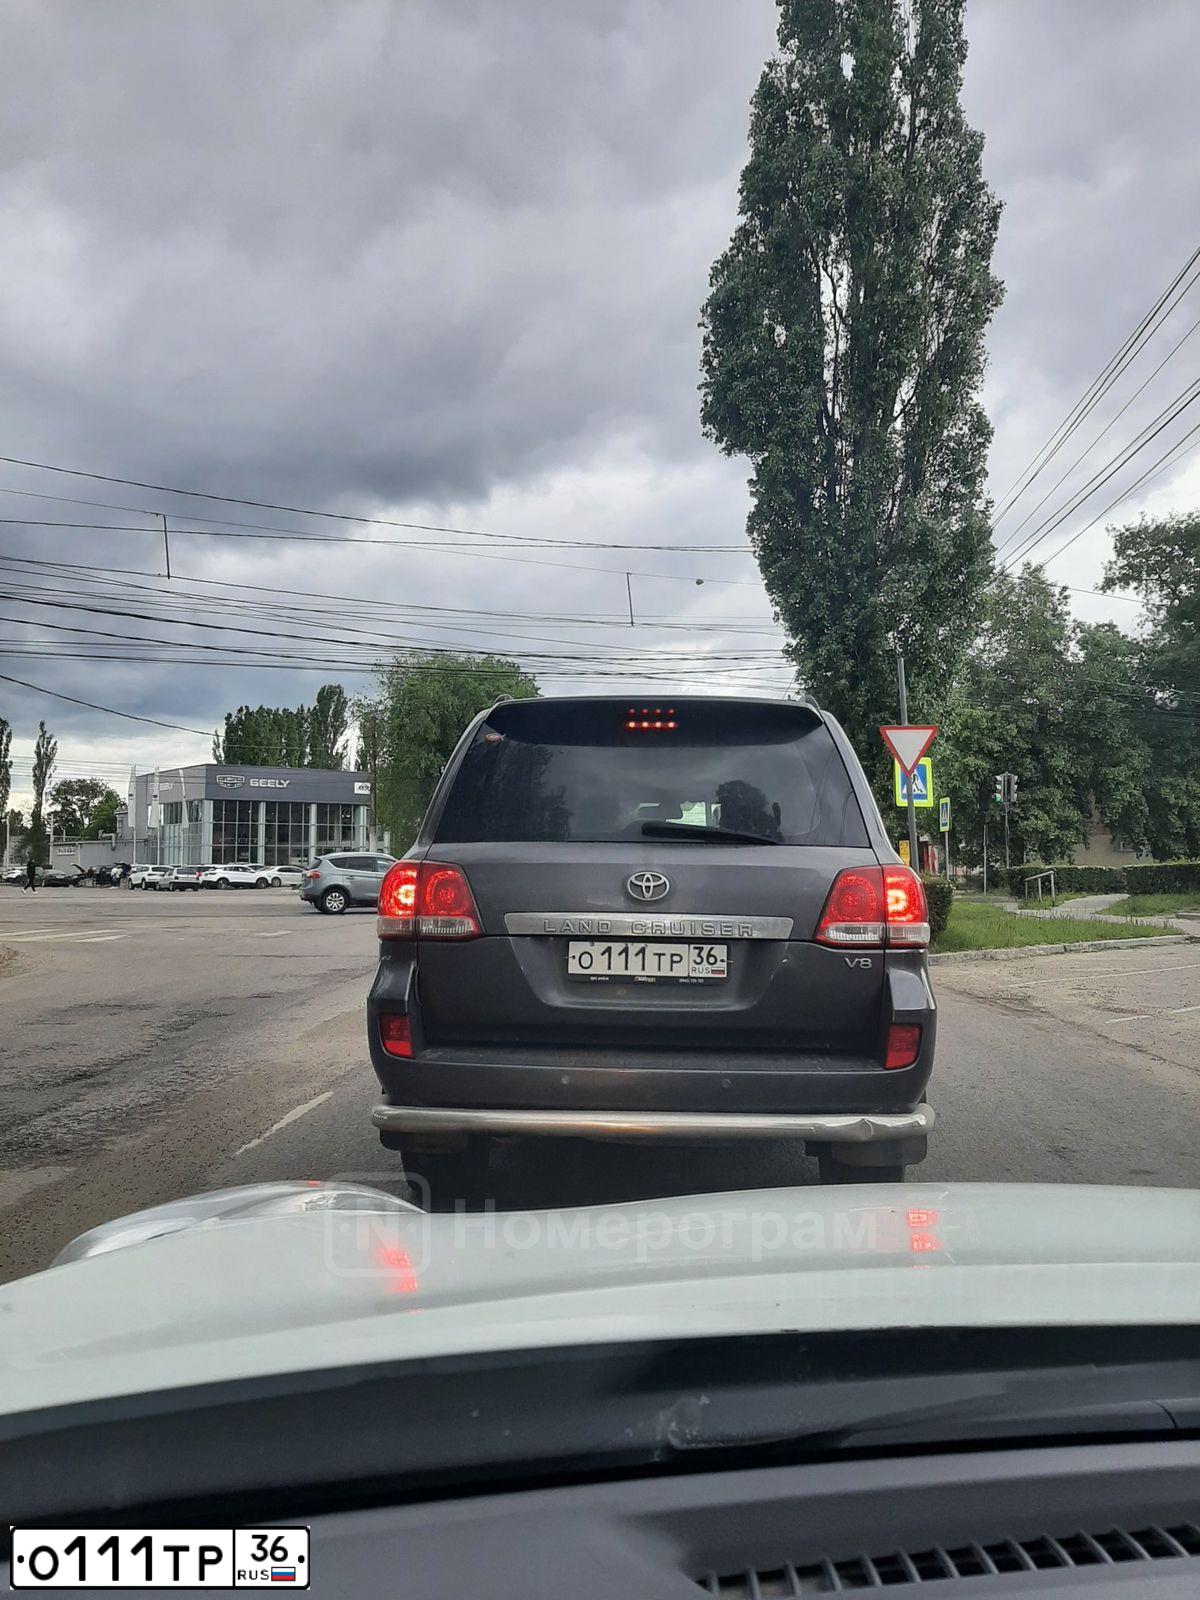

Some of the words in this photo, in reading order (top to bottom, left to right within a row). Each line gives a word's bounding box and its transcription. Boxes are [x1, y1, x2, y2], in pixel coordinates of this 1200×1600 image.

[250, 778, 290, 788] GEELY
[543, 919, 613, 934] LAND
[631, 920, 754, 937] CRUISER
[692, 946, 718, 966] 36
[844, 957, 872, 969] V8
[691, 966, 710, 975] RUS
